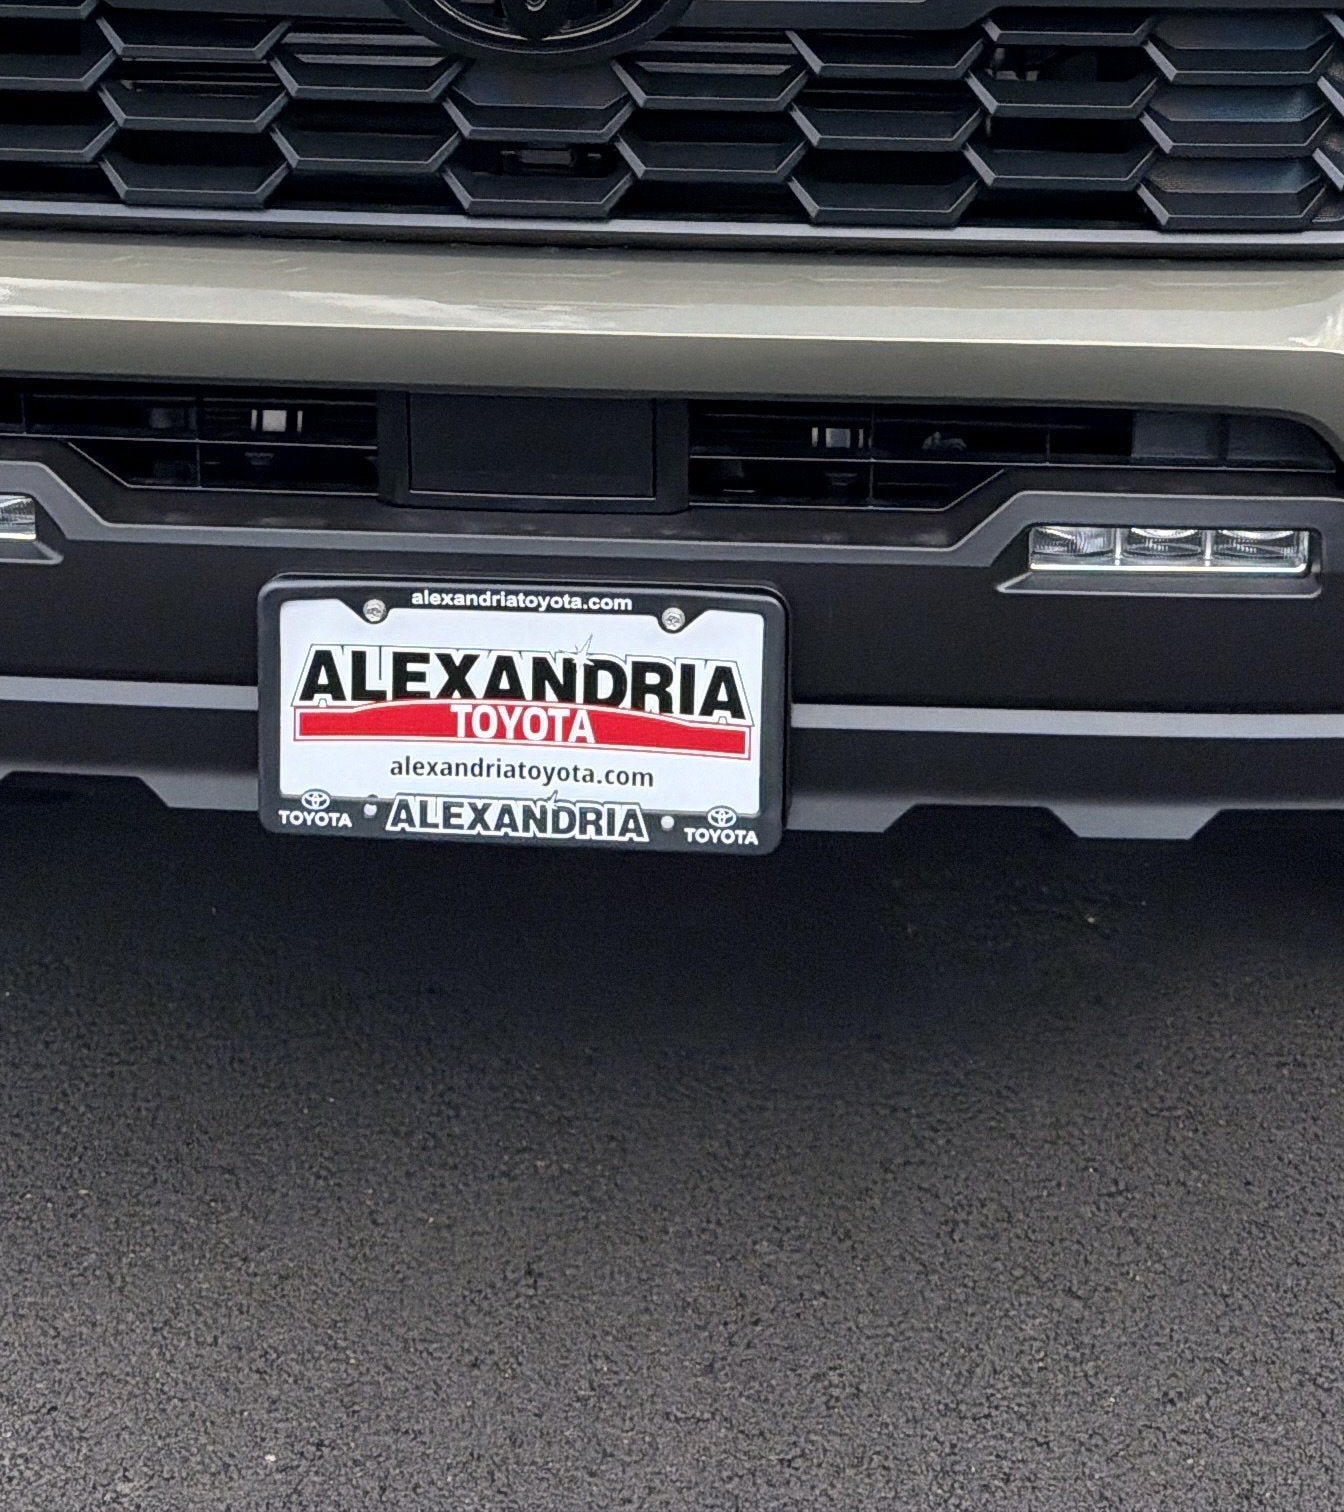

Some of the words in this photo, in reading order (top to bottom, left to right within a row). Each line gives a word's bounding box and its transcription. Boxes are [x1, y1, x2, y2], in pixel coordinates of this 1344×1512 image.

[410, 589, 634, 612] alexandriatoyota.com
[297, 648, 747, 722] ALEXANDRIA
[449, 703, 597, 745] TOYOTA
[389, 755, 655, 788] alexandriatoyota.com
[278, 808, 353, 829] TOYOTA
[386, 794, 649, 842] ALEXANDRIA
[683, 825, 759, 848] TOYOTA
